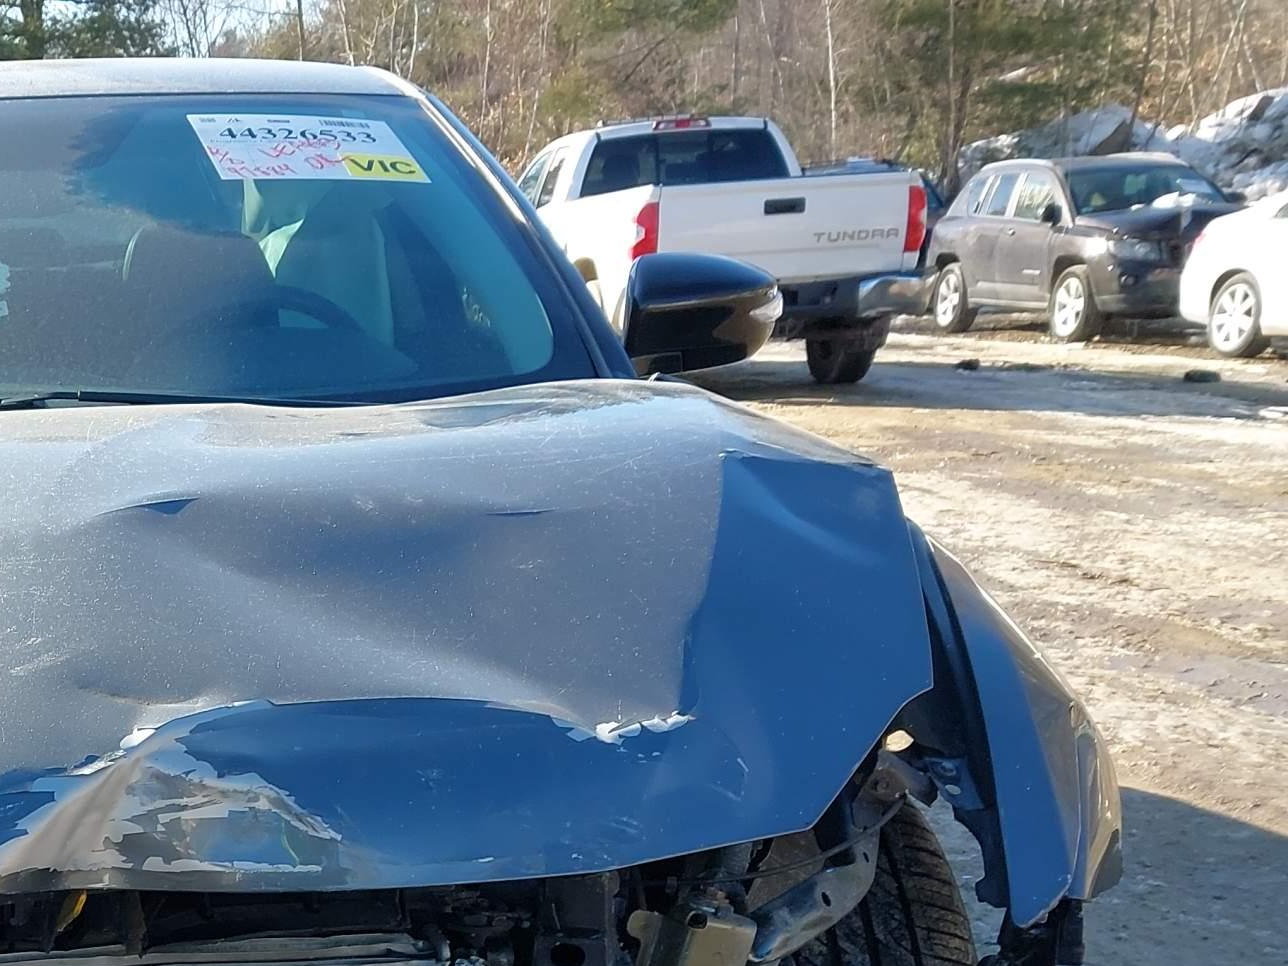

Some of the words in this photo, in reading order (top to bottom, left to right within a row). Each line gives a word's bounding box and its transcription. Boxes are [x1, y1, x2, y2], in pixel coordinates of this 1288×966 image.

[219, 126, 377, 144] 44326533
[349, 158, 417, 174] VIC
[812, 227, 900, 243] TUNDRA
